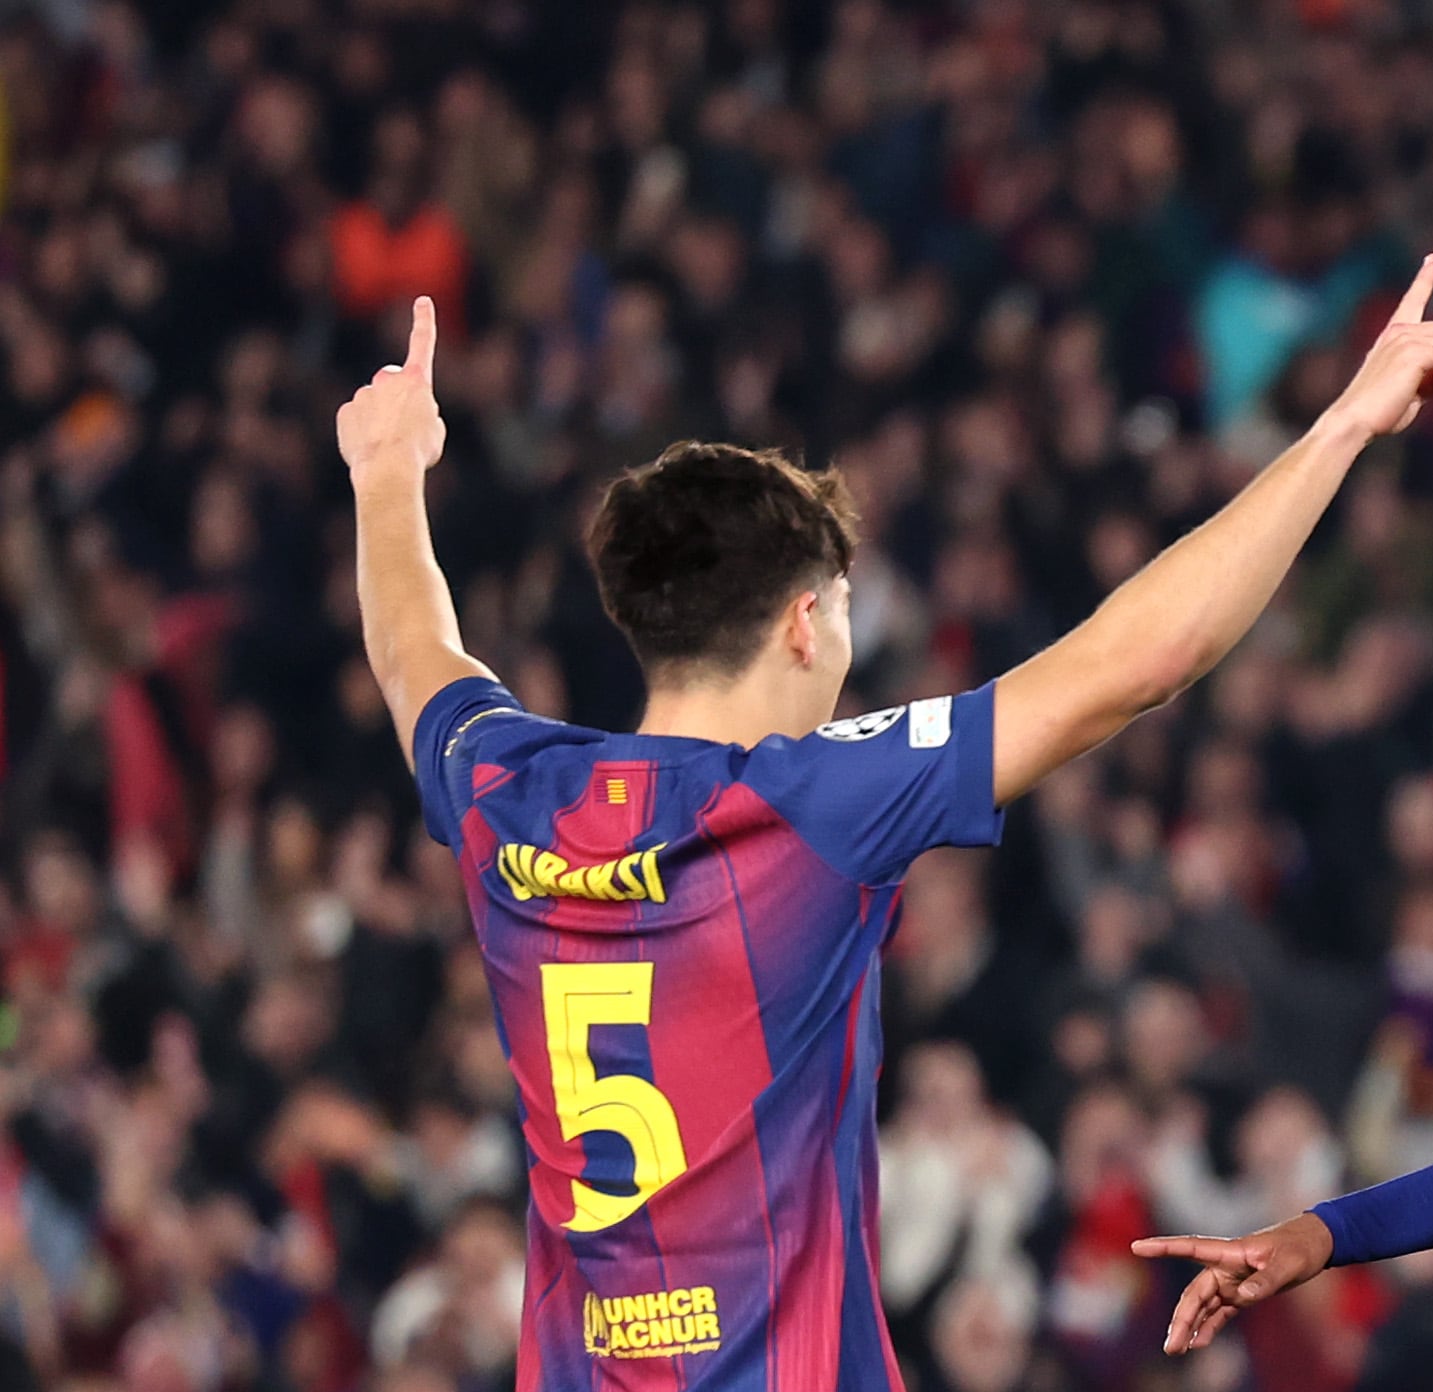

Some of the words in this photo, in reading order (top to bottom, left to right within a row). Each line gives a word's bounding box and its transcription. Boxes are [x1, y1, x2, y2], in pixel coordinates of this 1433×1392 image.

[540, 962, 689, 1232] 5
[603, 1286, 717, 1324] UNHCR
[611, 1313, 721, 1349] ACNUR
